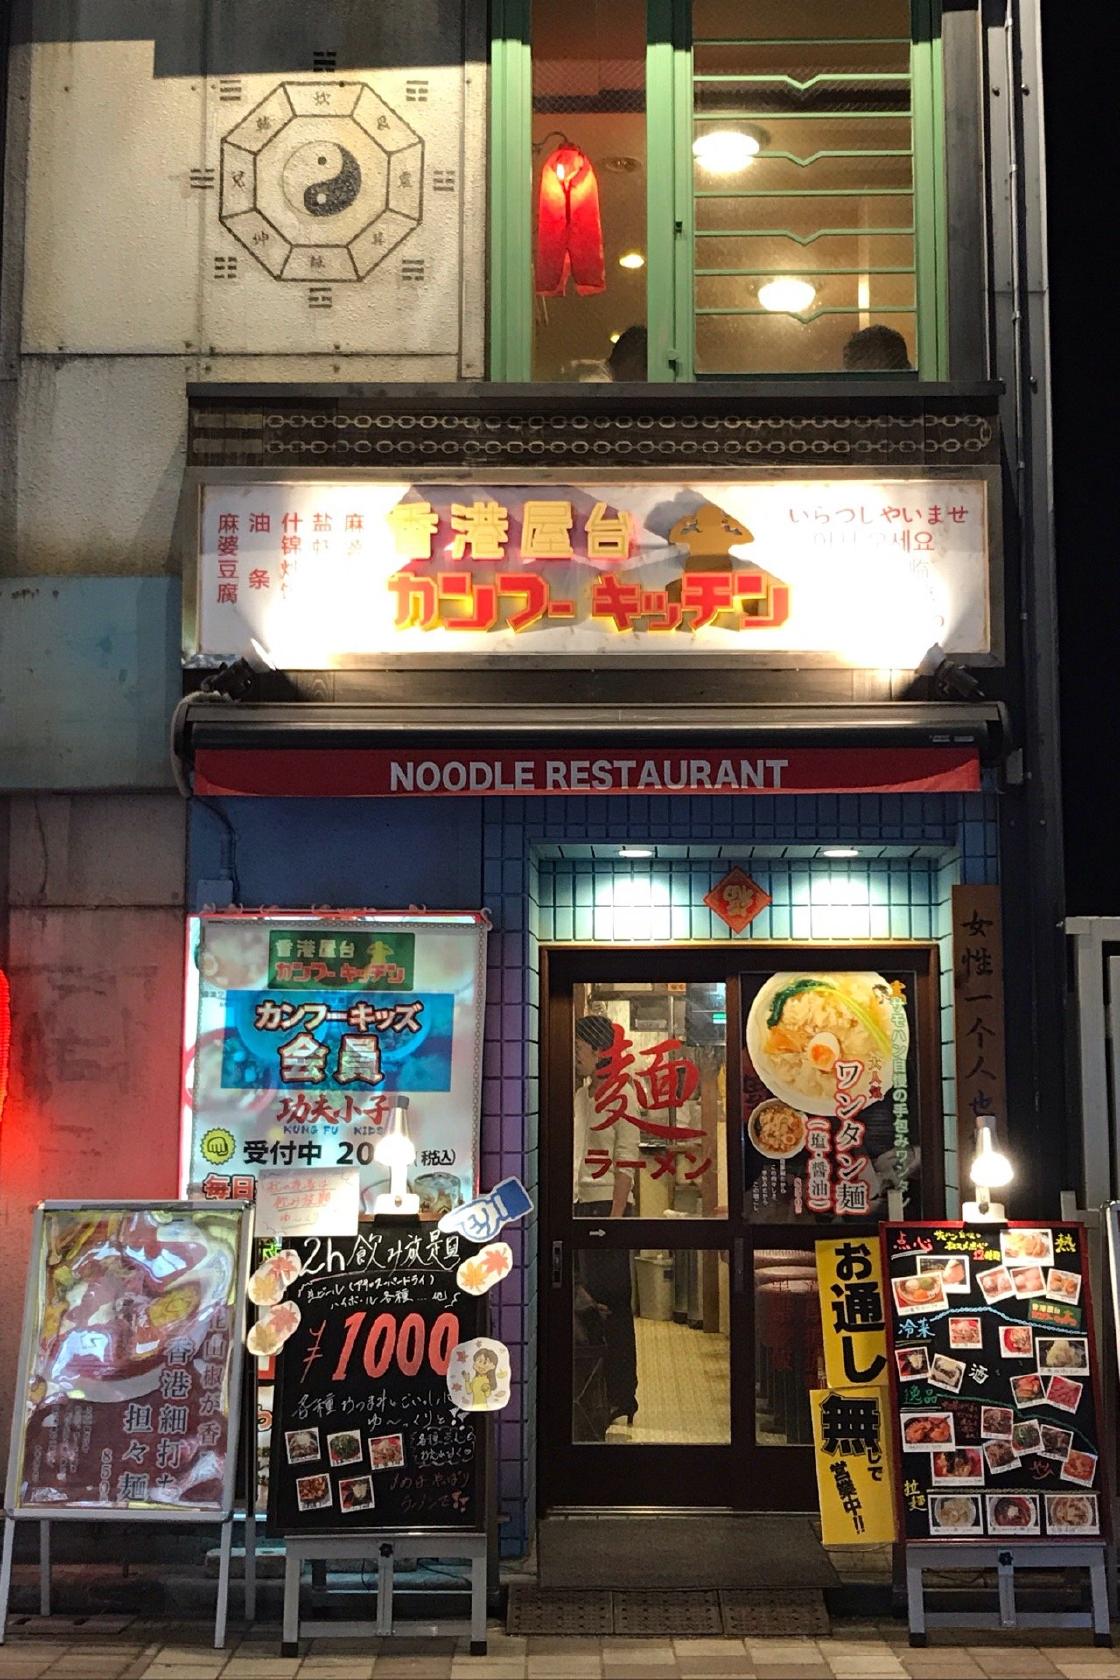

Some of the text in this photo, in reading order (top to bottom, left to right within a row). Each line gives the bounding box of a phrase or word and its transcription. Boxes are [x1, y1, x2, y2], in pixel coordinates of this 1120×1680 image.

[387, 501, 635, 560] 香港屋台
[216, 513, 240, 604] 麻婆豆腐
[248, 512, 270, 589] 油条
[390, 759, 789, 791] NOODLE RESTAURANT
[275, 939, 355, 958] 香港屋台
[254, 1000, 424, 1032] カンフーキッズ
[277, 1032, 384, 1086] 会員
[590, 1022, 708, 1140] 麺
[276, 1094, 391, 1125] 功夫小子
[283, 1126, 385, 1136] KUNG FU KIDS
[835, 1060, 870, 1214] ワンタン麺
[243, 1140, 322, 1166] 受付中
[584, 1148, 713, 1180] ラーメン
[202, 1172, 255, 1200] 毎日
[893, 1231, 934, 1251] 点心
[831, 1243, 887, 1384] お通し
[898, 1319, 936, 1339] 冷菜
[300, 1312, 460, 1384] ¥1000
[967, 1363, 990, 1385] 酒
